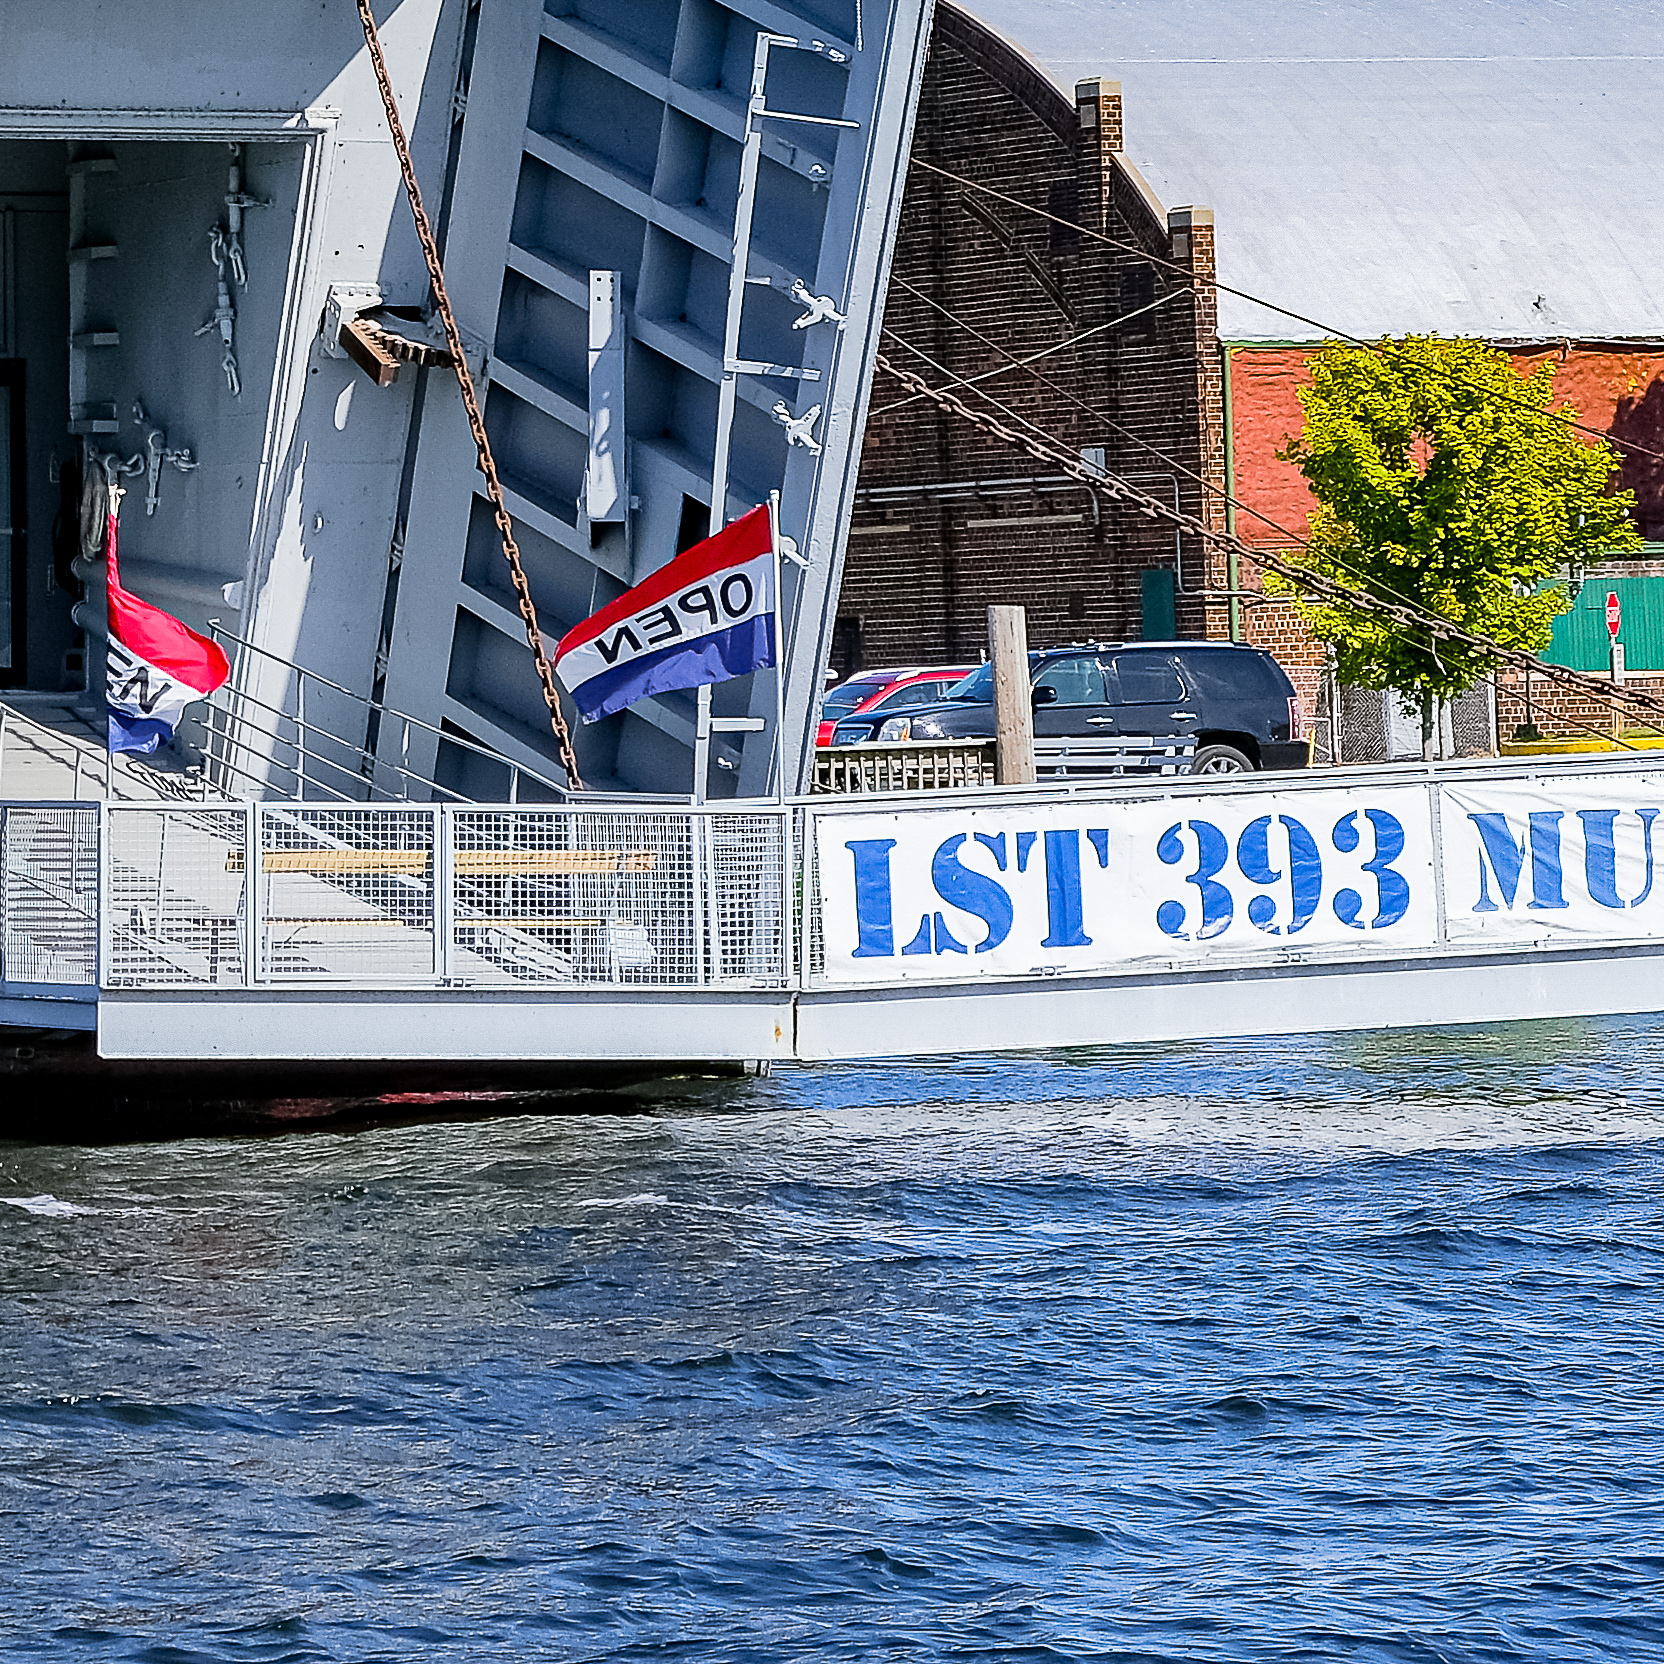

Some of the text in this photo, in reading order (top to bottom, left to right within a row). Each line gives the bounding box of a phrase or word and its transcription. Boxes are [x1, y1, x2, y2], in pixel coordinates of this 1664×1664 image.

[845, 807, 1662, 958] LST 393 MU
